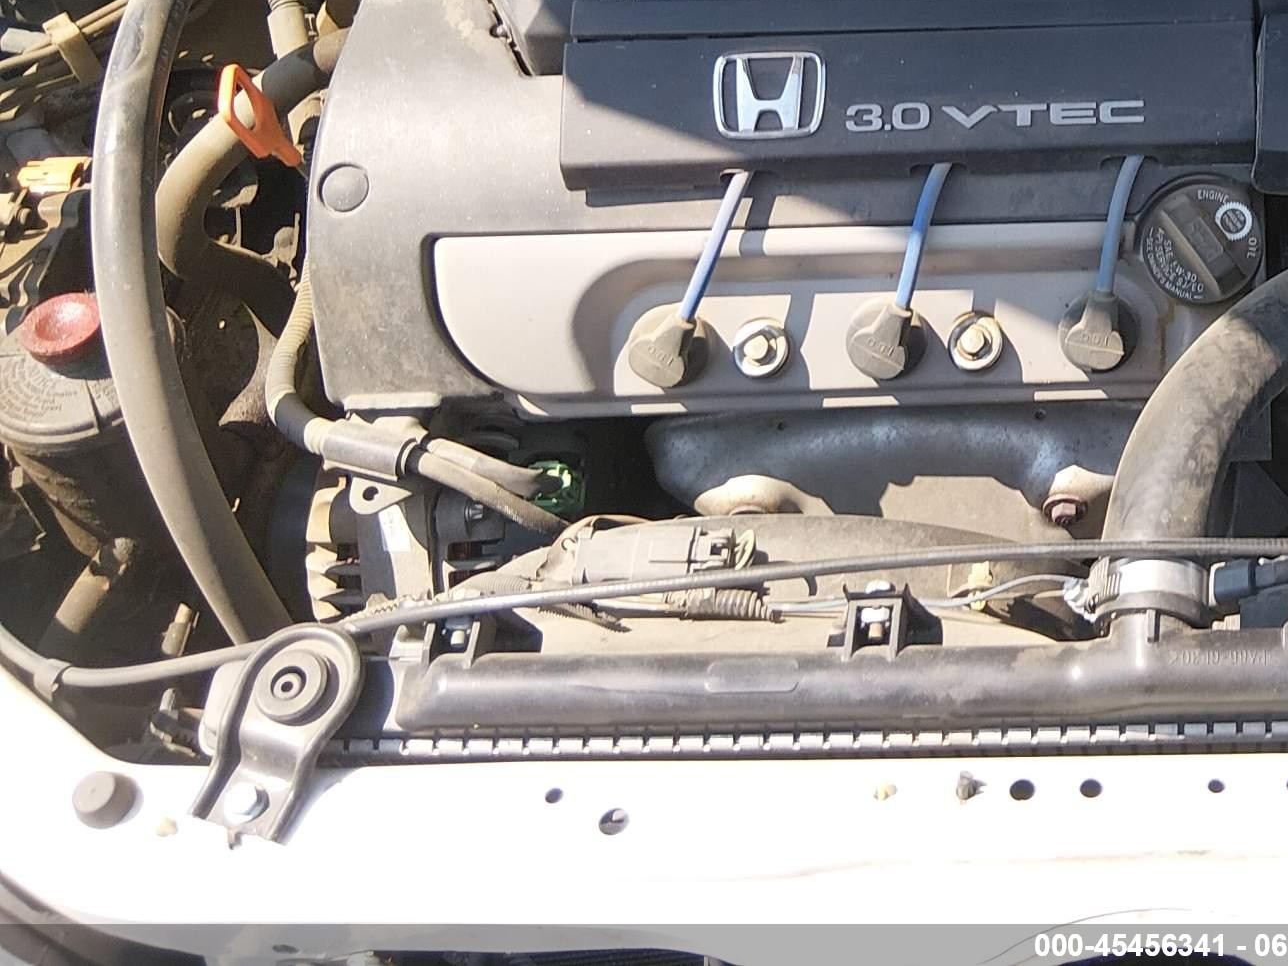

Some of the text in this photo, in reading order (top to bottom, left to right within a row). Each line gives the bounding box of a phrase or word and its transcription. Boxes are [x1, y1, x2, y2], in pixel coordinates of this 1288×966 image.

[845, 99, 1147, 132] 3.0 VTEC
[1197, 189, 1230, 204] ENGINE
[1247, 237, 1257, 259] OIL
